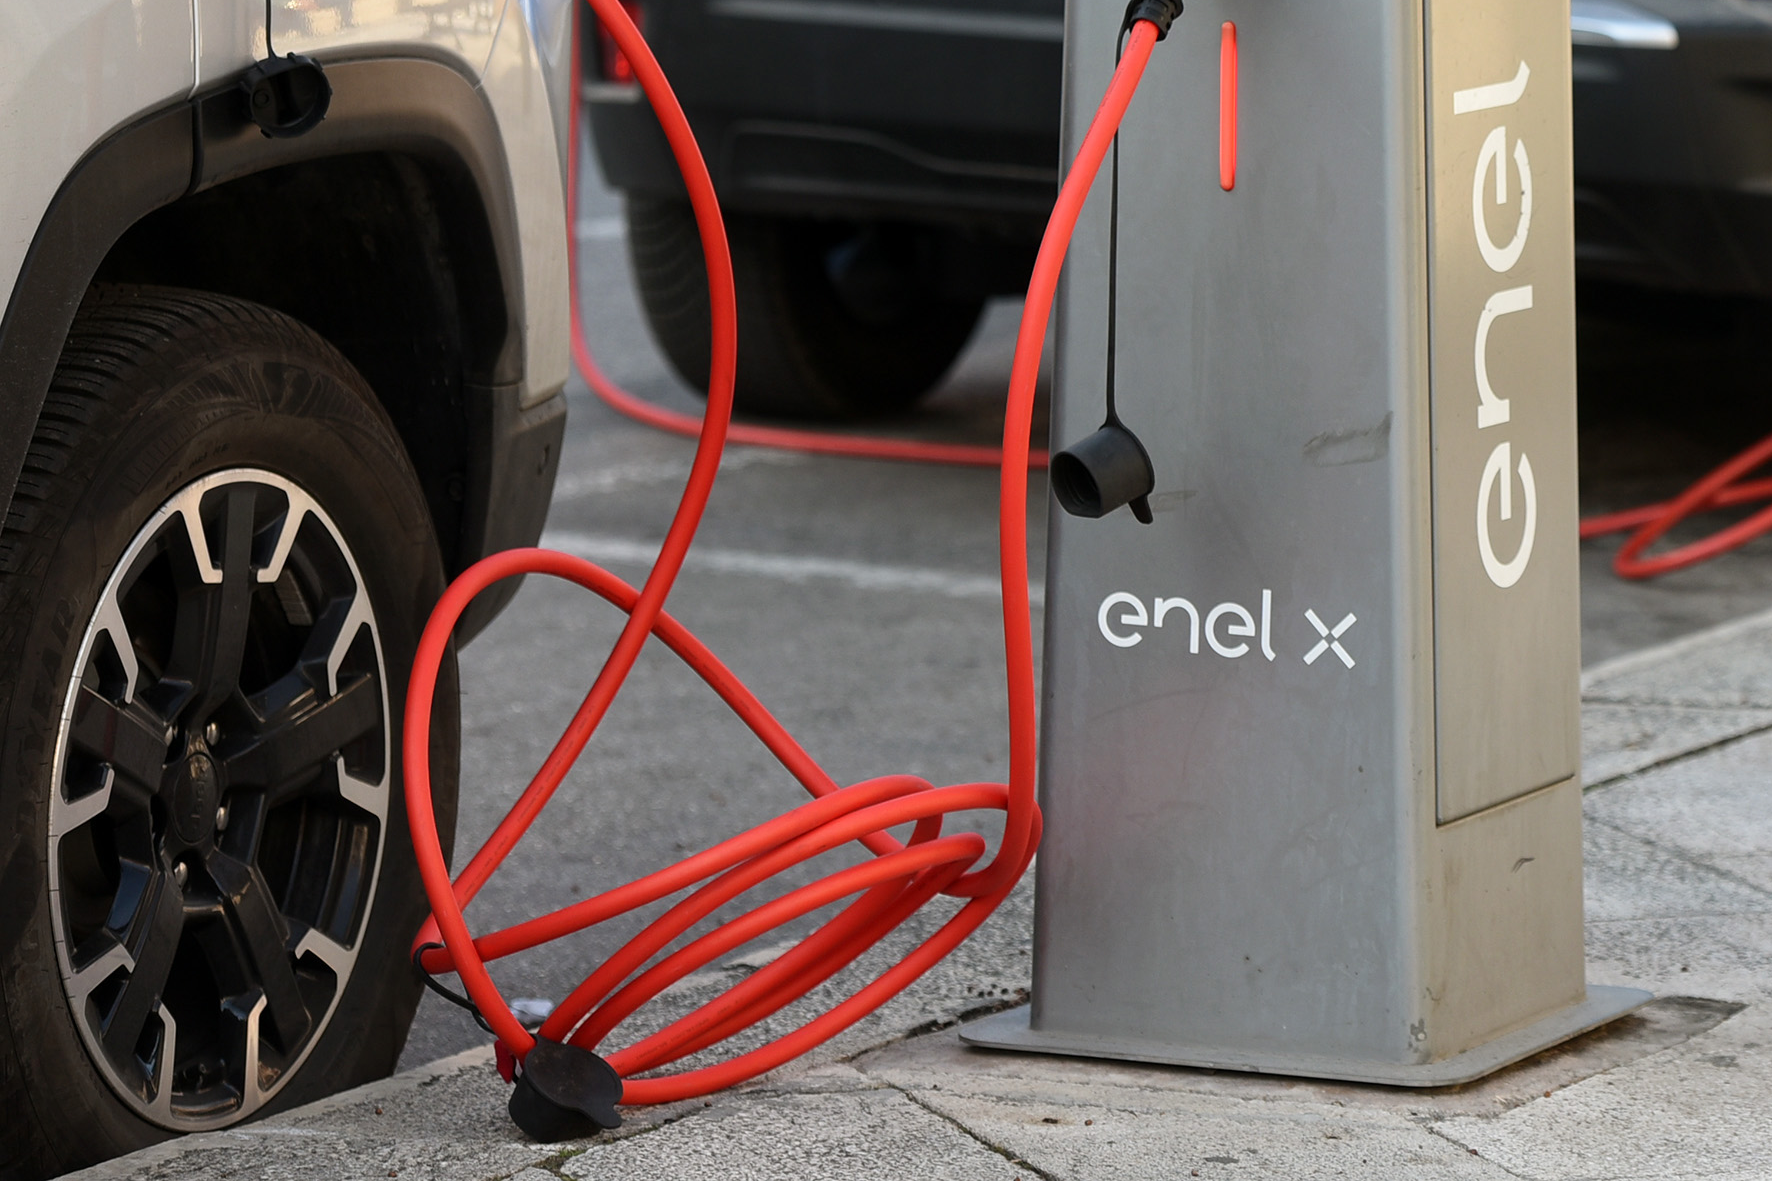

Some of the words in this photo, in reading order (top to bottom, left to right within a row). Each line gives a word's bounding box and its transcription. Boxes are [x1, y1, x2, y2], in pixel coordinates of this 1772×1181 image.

[1453, 59, 1537, 589] enel
[1098, 588, 1276, 662] enel
[1302, 607, 1358, 670] x
